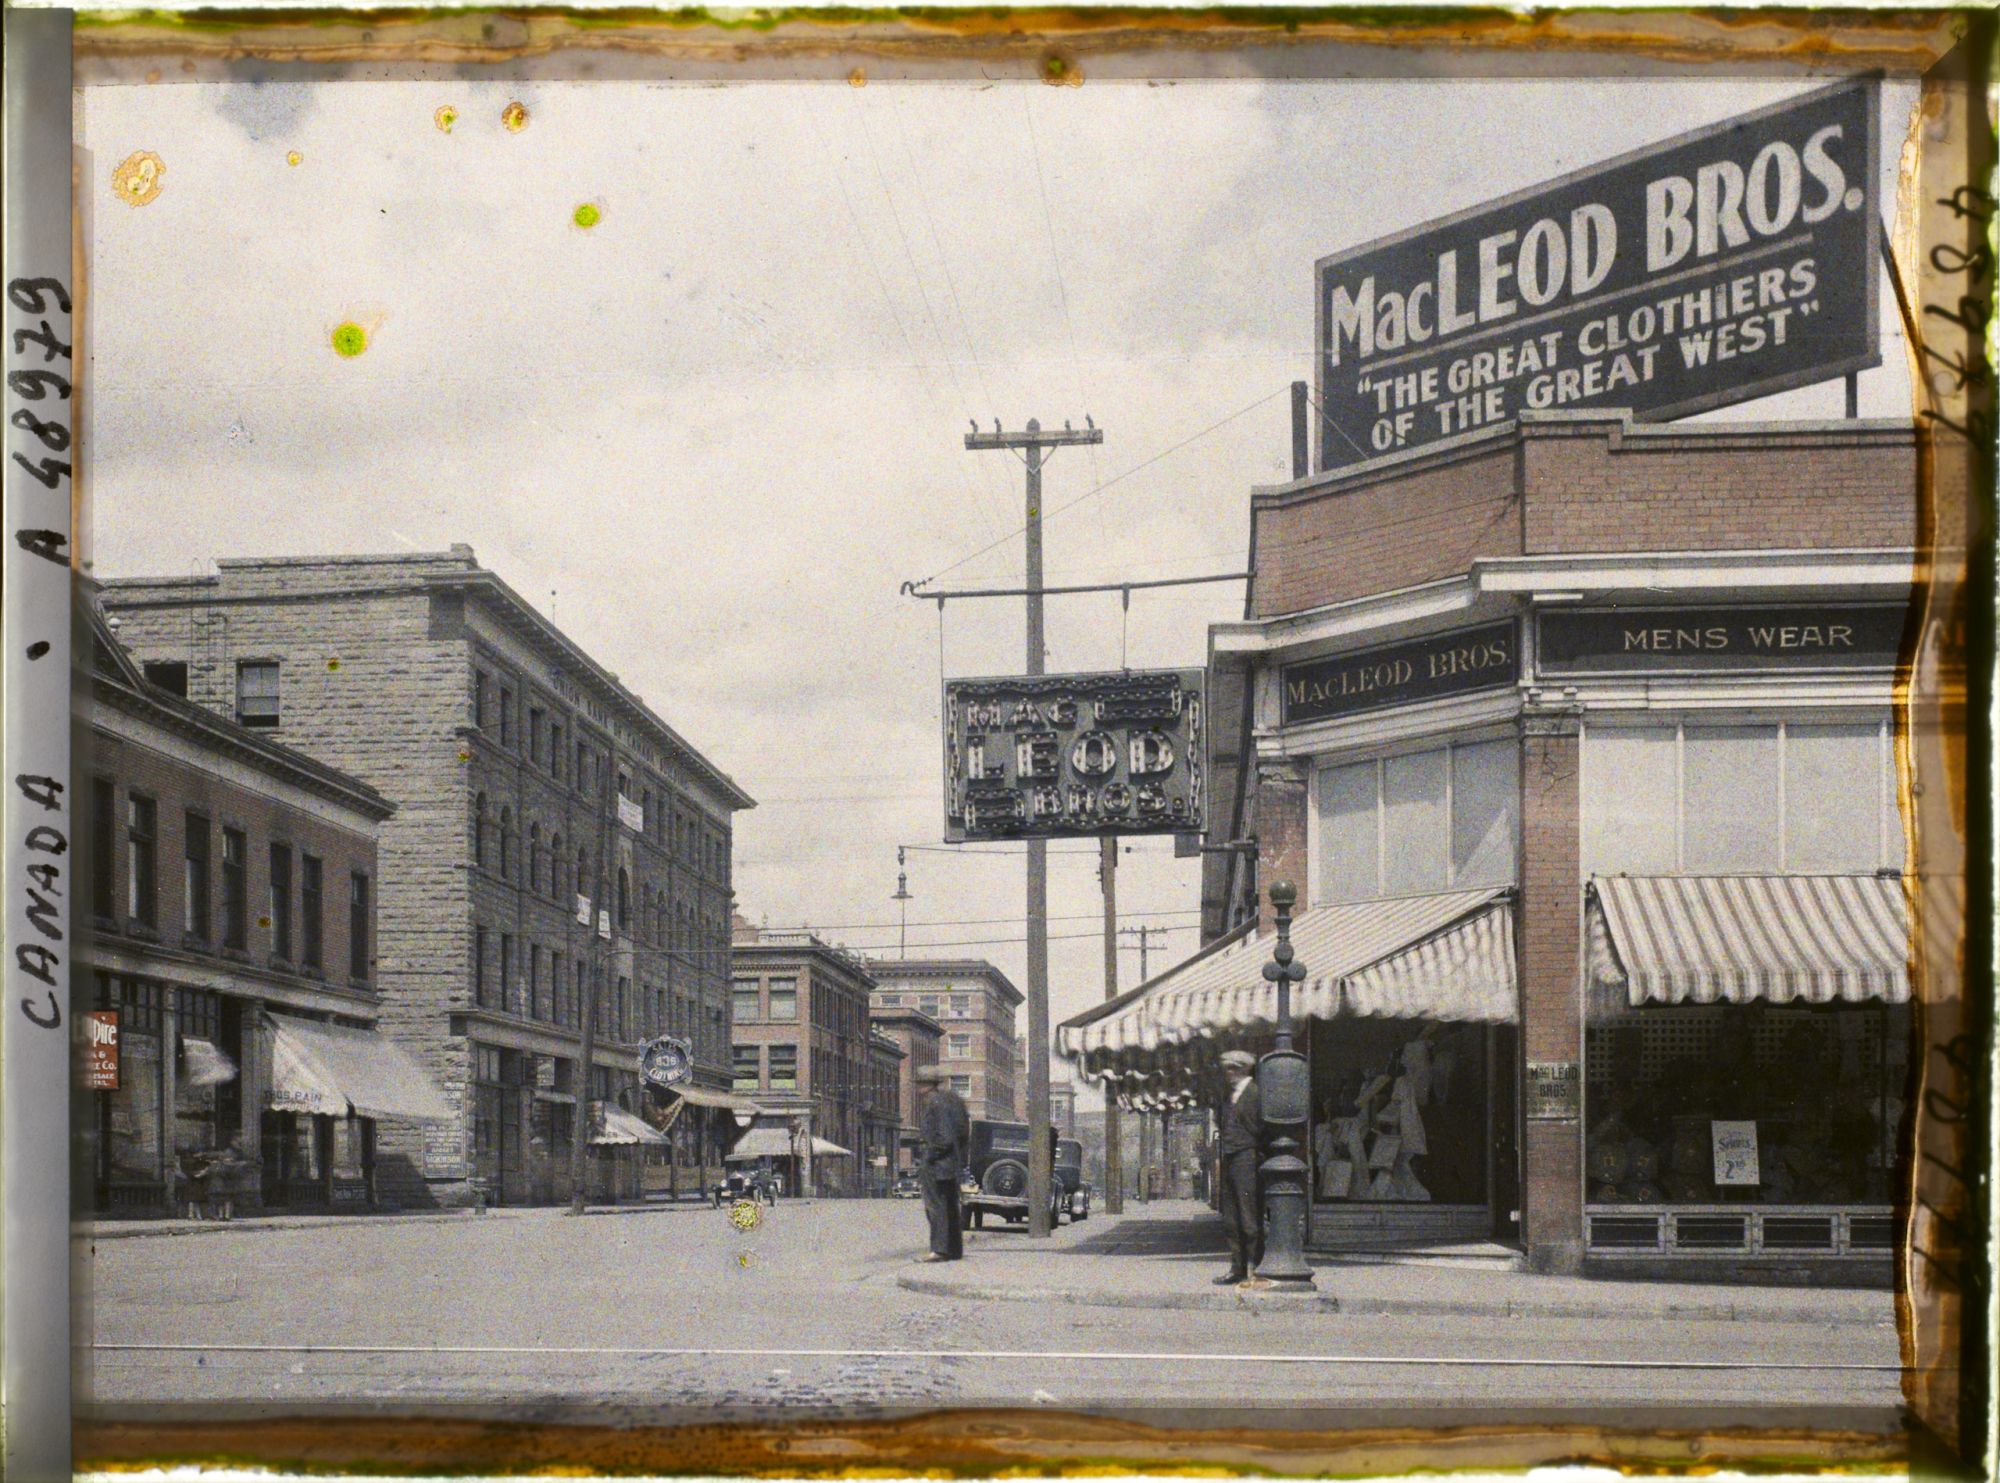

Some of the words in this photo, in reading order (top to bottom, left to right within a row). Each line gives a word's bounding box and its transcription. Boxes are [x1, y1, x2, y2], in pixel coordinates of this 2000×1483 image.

[1331, 203, 1617, 366] MacLEOD
[1646, 124, 1864, 274] BROS.
[1447, 331, 1562, 396] GREAT
[1578, 258, 1818, 357] CLOTHIERS
[6, 276, 71, 490] 48979
[1371, 417, 1415, 451] OF
[1434, 387, 1504, 435] THE
[1525, 347, 1660, 411] GREAT
[17, 528, 70, 567] A
[1428, 640, 1512, 678] BROS.
[1624, 627, 1728, 650] MENS
[1748, 626, 1854, 648] WEAR
[967, 729, 1174, 786] LEOD
[1033, 783, 1184, 816] BROS.
[15, 774, 67, 1028] CANADA
